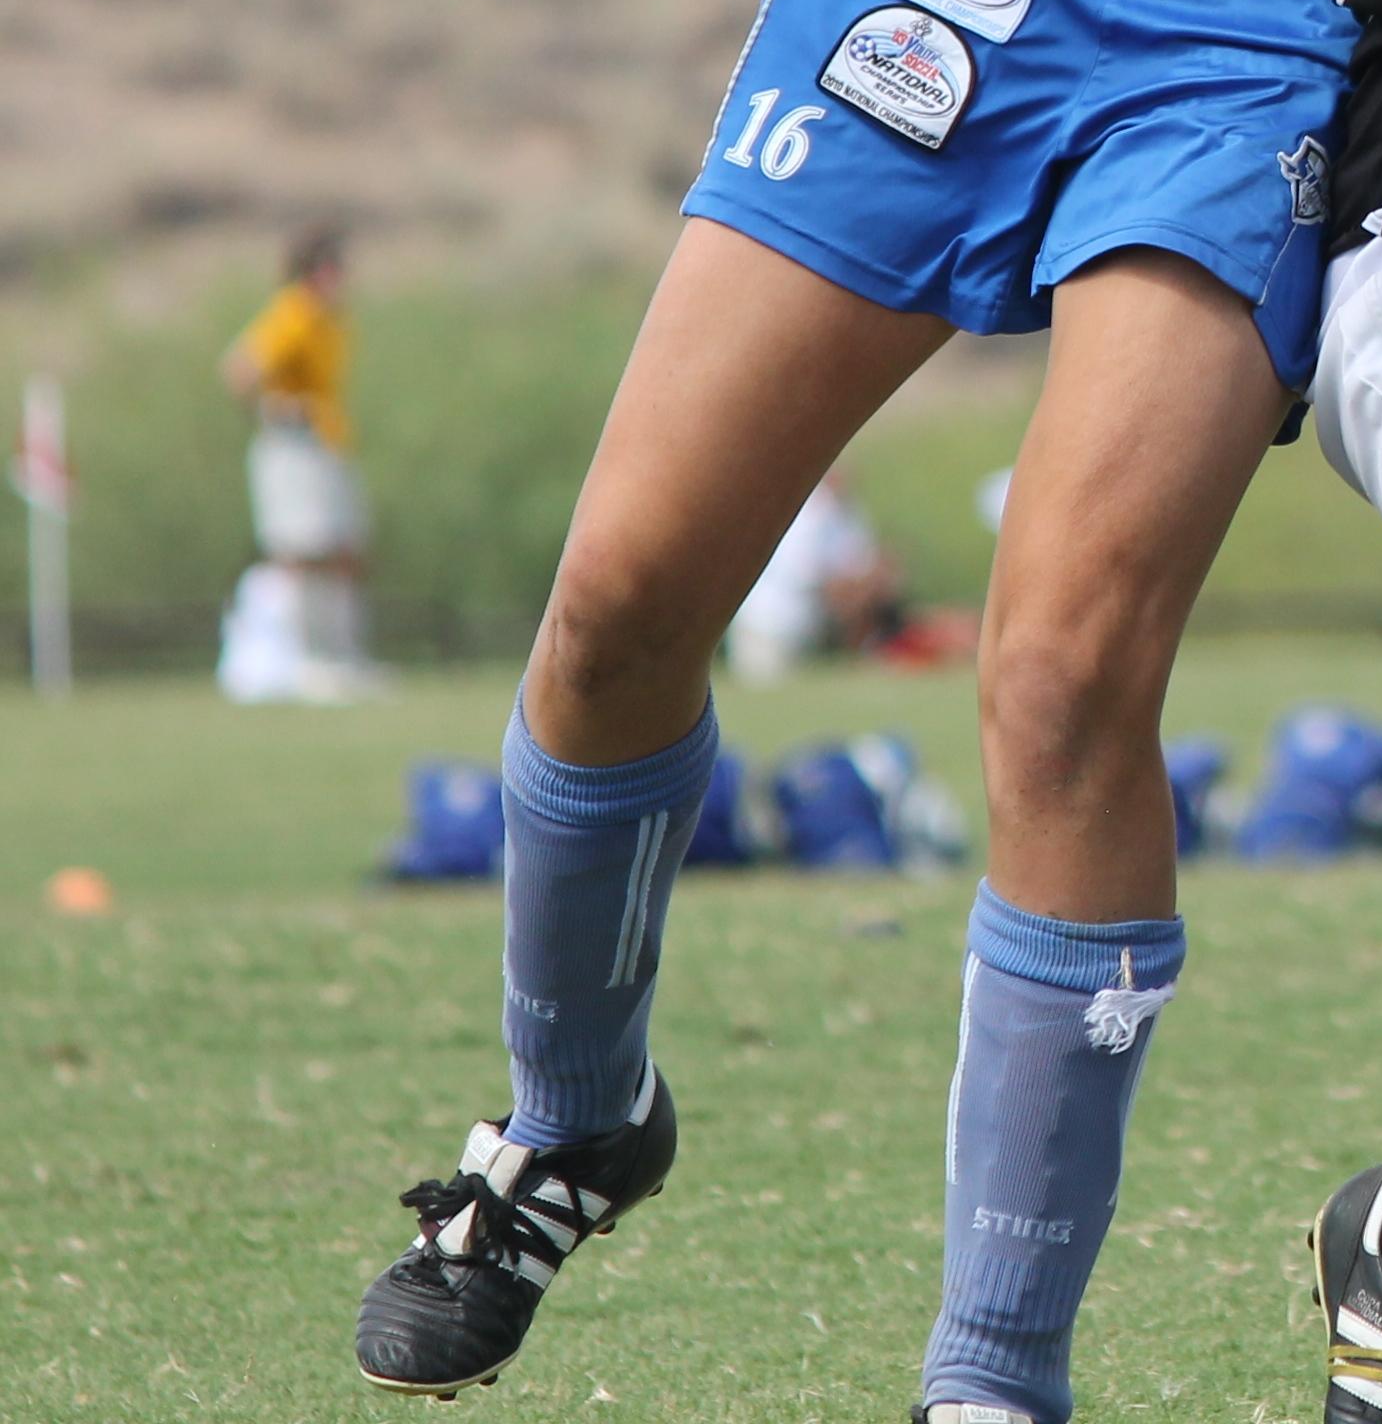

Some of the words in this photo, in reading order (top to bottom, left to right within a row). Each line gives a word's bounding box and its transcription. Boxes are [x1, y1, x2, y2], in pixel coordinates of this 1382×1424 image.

[867, 53, 949, 106] NATIONAL
[722, 87, 827, 181] 16
[972, 1206, 1075, 1245] STING
